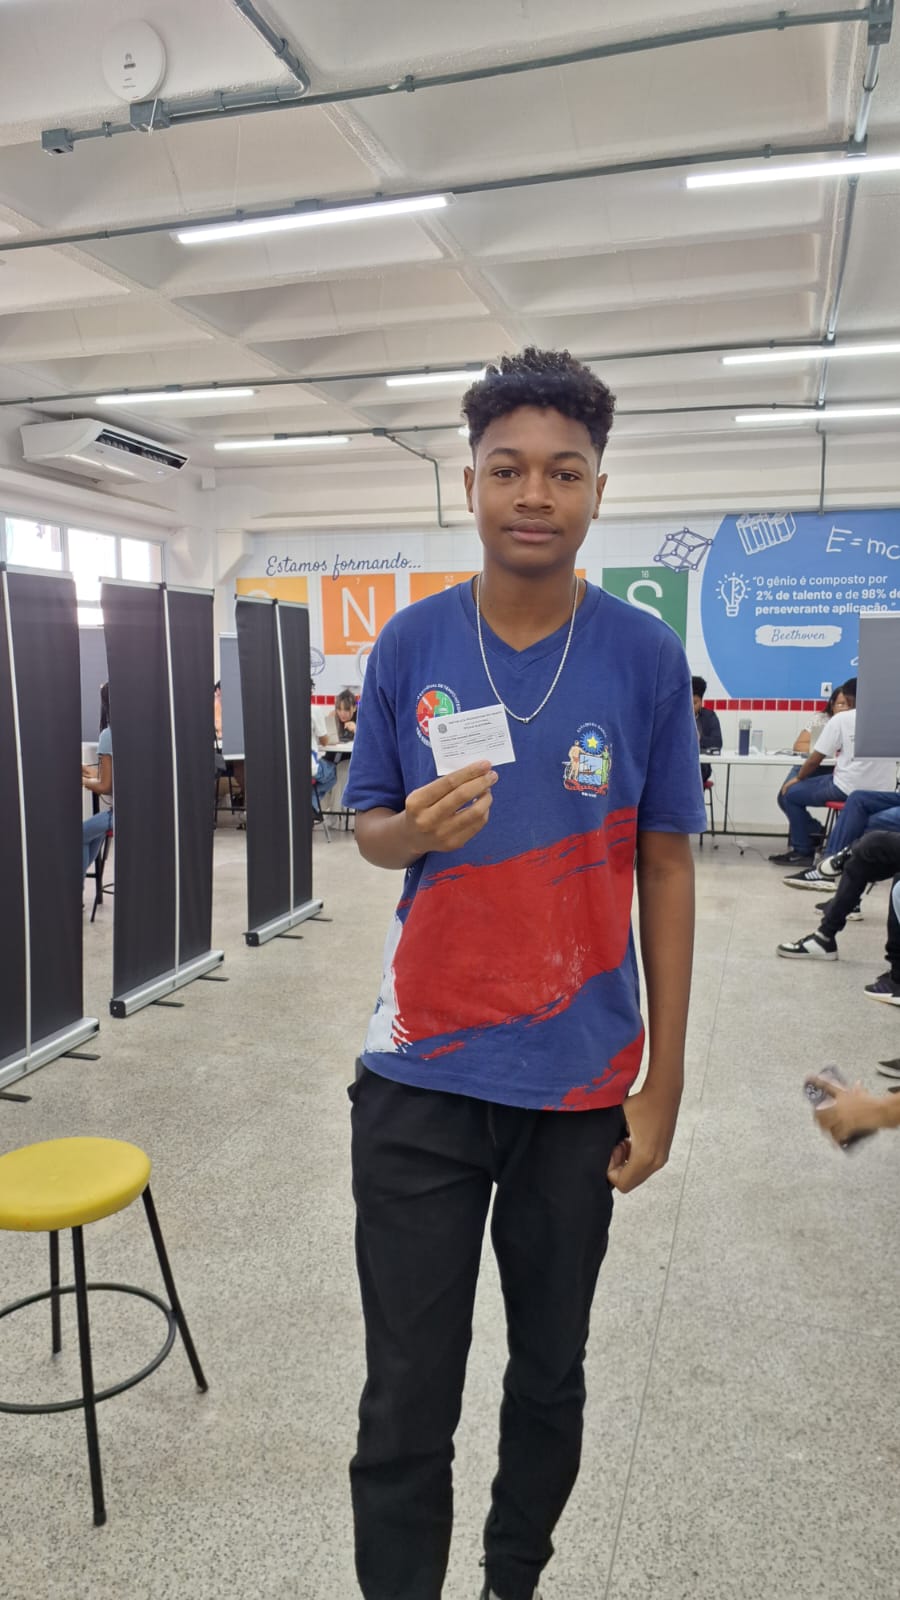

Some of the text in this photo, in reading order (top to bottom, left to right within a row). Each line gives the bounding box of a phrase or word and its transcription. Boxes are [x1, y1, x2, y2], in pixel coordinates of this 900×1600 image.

[266, 552, 421, 581] Estamos formando...
[767, 576, 797, 588] gênio
[800, 576, 806, 585] é
[809, 575, 865, 587] composto
[868, 575, 888, 586] por
[756, 590, 773, 600] 2%
[776, 590, 790, 600] de
[793, 590, 832, 600] talento
[836, 591, 842, 600] e
[845, 590, 859, 600] de
[861, 589, 886, 599] 98%
[342, 586, 375, 637] N
[755, 605, 829, 616] perseverante
[771, 629, 825, 643] Beethoven
